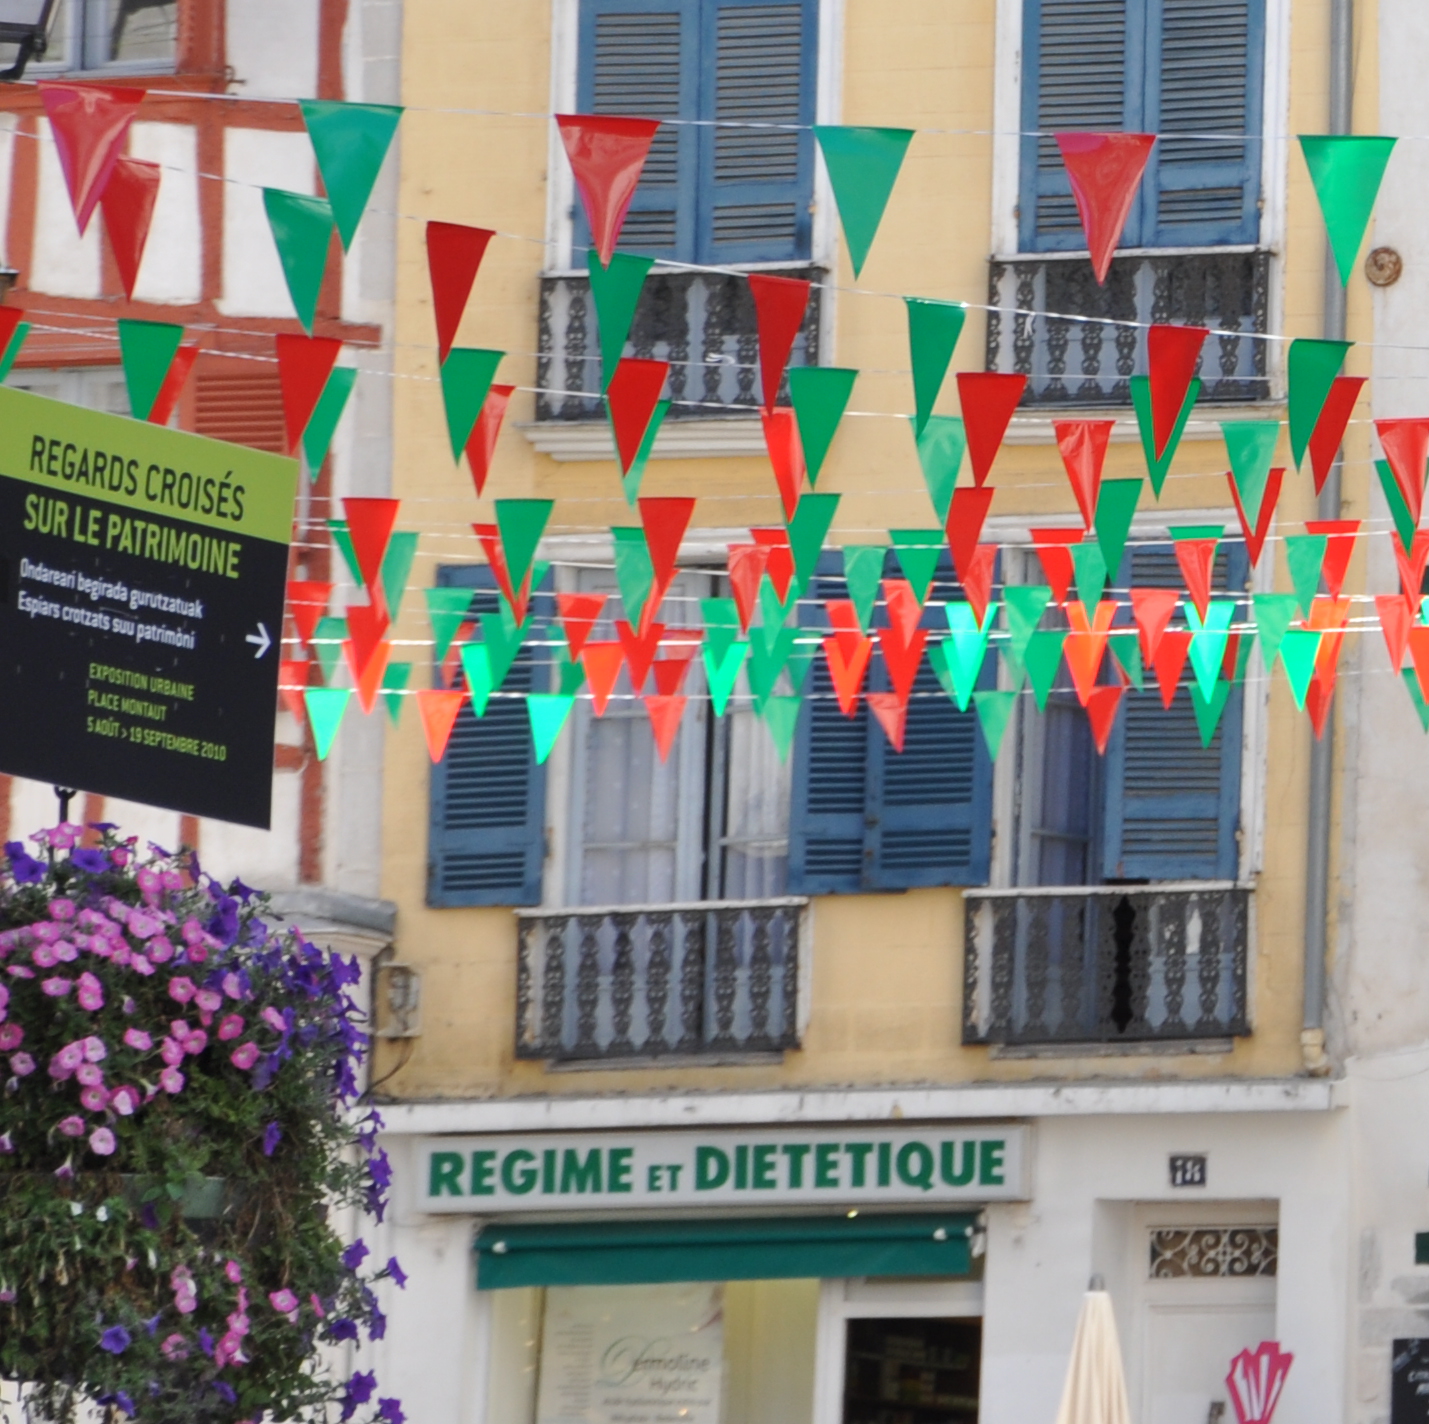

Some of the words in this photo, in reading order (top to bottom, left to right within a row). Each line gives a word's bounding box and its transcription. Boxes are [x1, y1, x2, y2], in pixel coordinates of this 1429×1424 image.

[30, 434, 139, 497] REGARDS
[145, 463, 246, 522] CROISÉS
[23, 493, 69, 538] SUR
[73, 505, 102, 546] LE
[106, 513, 242, 579] PATRIMOINE
[77, 572, 128, 601] begirada
[129, 588, 204, 619] gurutzatuak
[88, 689, 120, 711] PLACE
[89, 662, 148, 690] EXPOSITION
[150, 676, 195, 701] URBAINE
[87, 716, 94, 732] 5
[95, 716, 121, 737] AOÛT
[130, 726, 142, 744] 19
[143, 728, 200, 756] SEPTEMBRE
[201, 741, 227, 762] 2010
[428, 1147, 634, 1197] REGIME
[647, 1164, 684, 1192] ET
[695, 1139, 1006, 1192] DIETETIQUE
